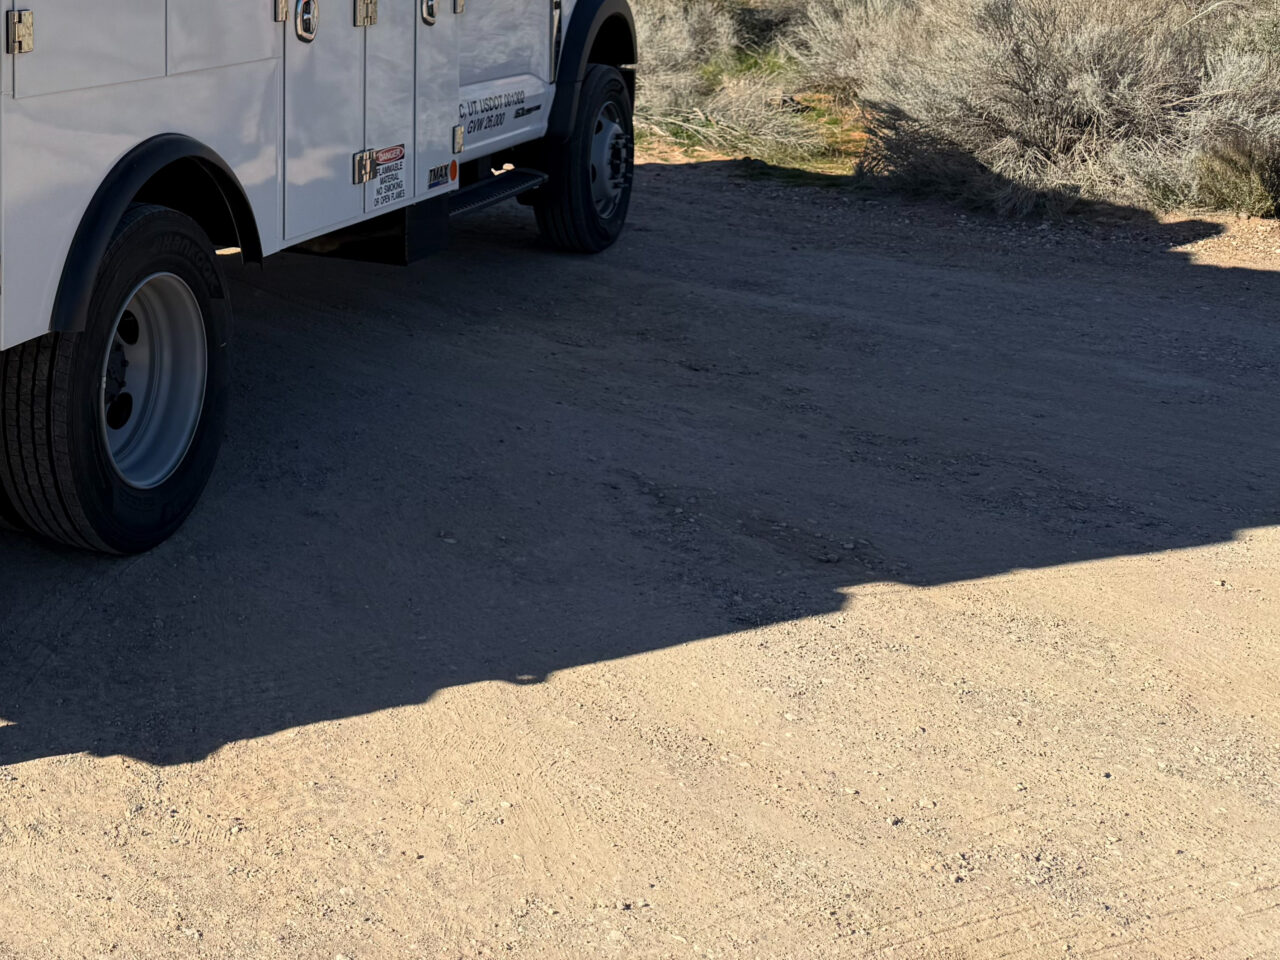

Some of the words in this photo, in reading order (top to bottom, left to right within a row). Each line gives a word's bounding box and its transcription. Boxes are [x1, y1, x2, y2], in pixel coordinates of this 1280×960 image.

[480, 94, 502, 114] USDOT
[467, 117, 483, 134] GVW
[378, 148, 401, 161] DANGER
[376, 161, 404, 177] FLAMMABLE
[380, 173, 400, 186] MATERIAL
[376, 186, 383, 197] NO
[383, 180, 404, 194] SMOKING
[373, 197, 380, 207] OR
[380, 193, 391, 205] OPEN
[391, 189, 406, 201] FLAMES
